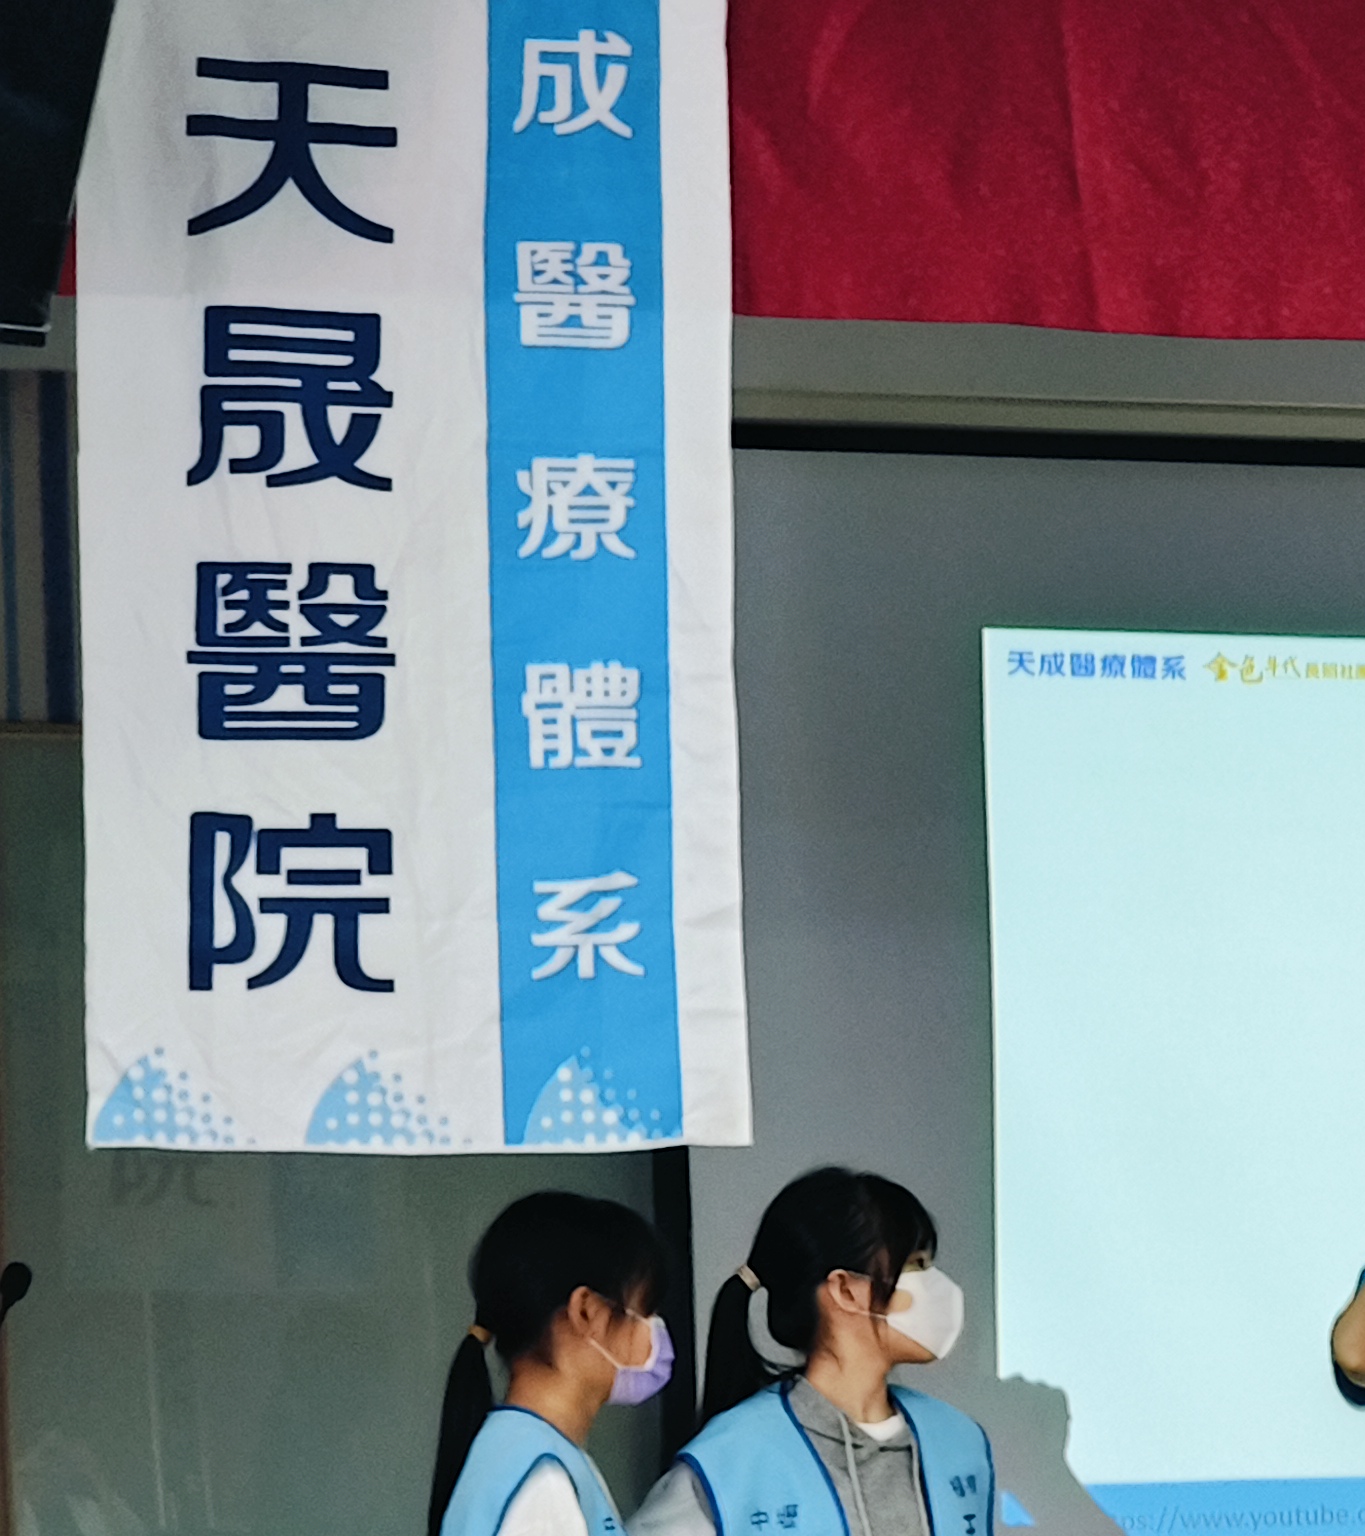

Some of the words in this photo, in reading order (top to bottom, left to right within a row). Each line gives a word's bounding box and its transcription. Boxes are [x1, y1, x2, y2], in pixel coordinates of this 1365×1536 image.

[185, 56, 397, 993] 天晟醫院
[513, 28, 646, 981] 成醫療體系
[1007, 651, 1187, 681] 天成醫療體系
